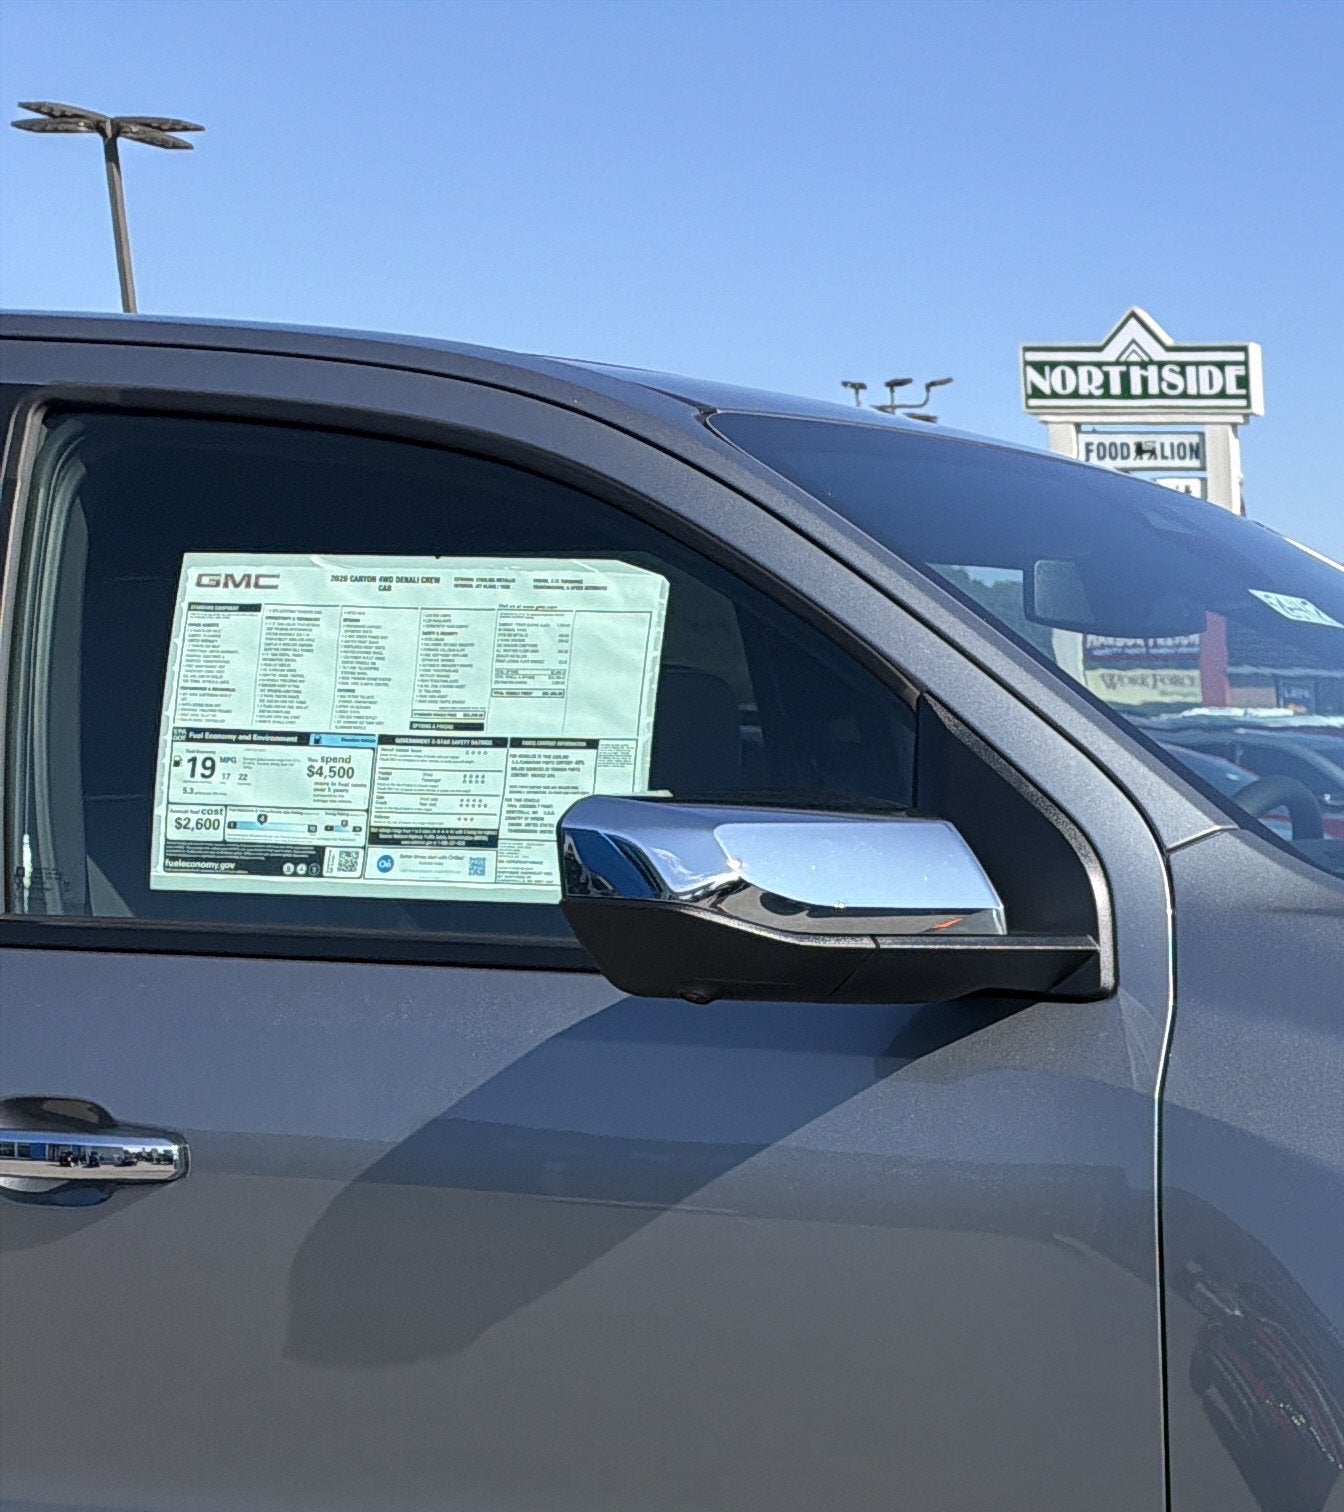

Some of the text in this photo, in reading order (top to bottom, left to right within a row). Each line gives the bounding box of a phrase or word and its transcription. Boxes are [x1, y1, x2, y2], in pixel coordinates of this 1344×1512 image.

[1025, 364, 1248, 396] NORTHSIDE
[1084, 441, 1201, 463] FOOD LION
[195, 573, 281, 590] GMC
[189, 731, 298, 743] Fuel Economy and Environment
[320, 754, 352, 765] spend
[186, 756, 217, 779] 19
[219, 756, 237, 764] MPG
[306, 764, 355, 780] $4,500
[222, 772, 231, 780] 17
[238, 773, 248, 781] 22
[200, 807, 225, 817] cost
[174, 816, 221, 832] $2,600
[164, 858, 236, 871] fueleconomy.gov
